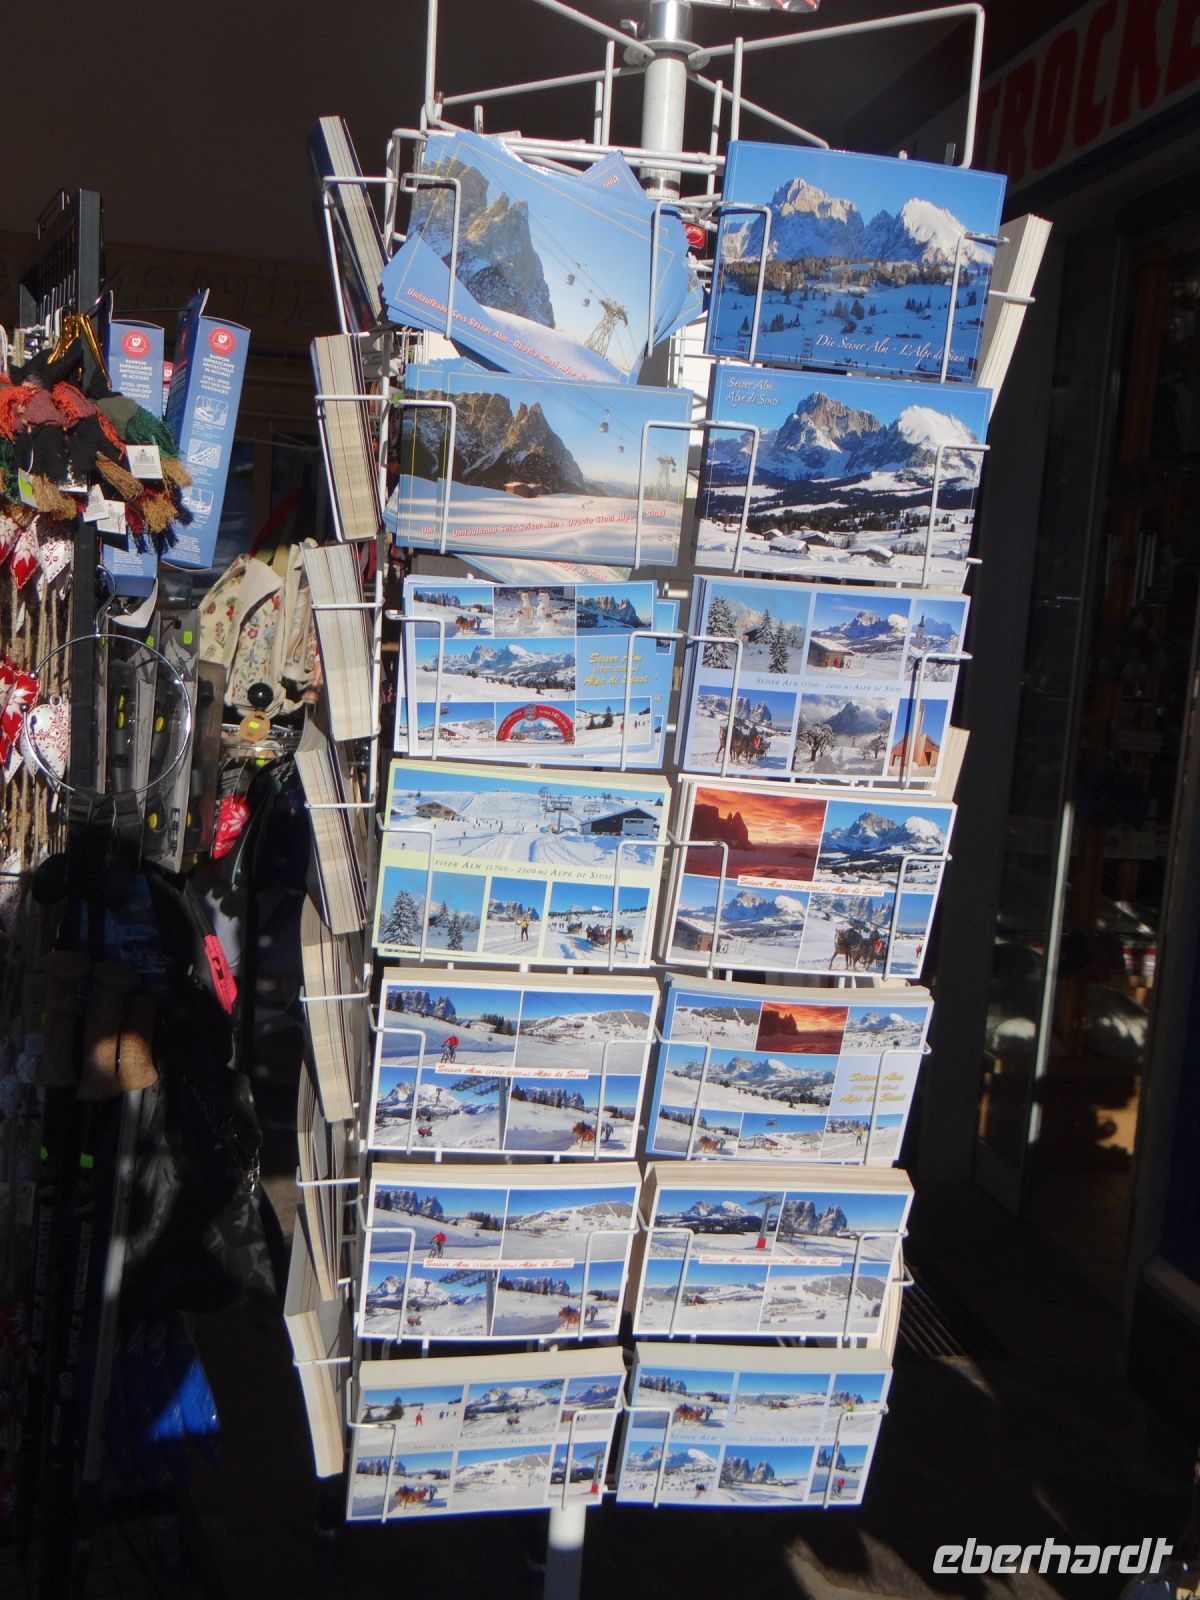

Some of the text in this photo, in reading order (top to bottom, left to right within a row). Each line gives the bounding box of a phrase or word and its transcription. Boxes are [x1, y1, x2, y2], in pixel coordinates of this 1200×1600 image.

[815, 334, 835, 347] Die
[838, 336, 866, 351] Seiser
[866, 335, 890, 354] Alm
[782, 679, 799, 687] ALM
[854, 683, 872, 692] ALPE
[433, 858, 459, 869] EISER
[462, 861, 483, 870] ALM
[550, 868, 573, 878] ALPE
[576, 871, 586, 879] DI
[588, 871, 613, 881] SIUSI
